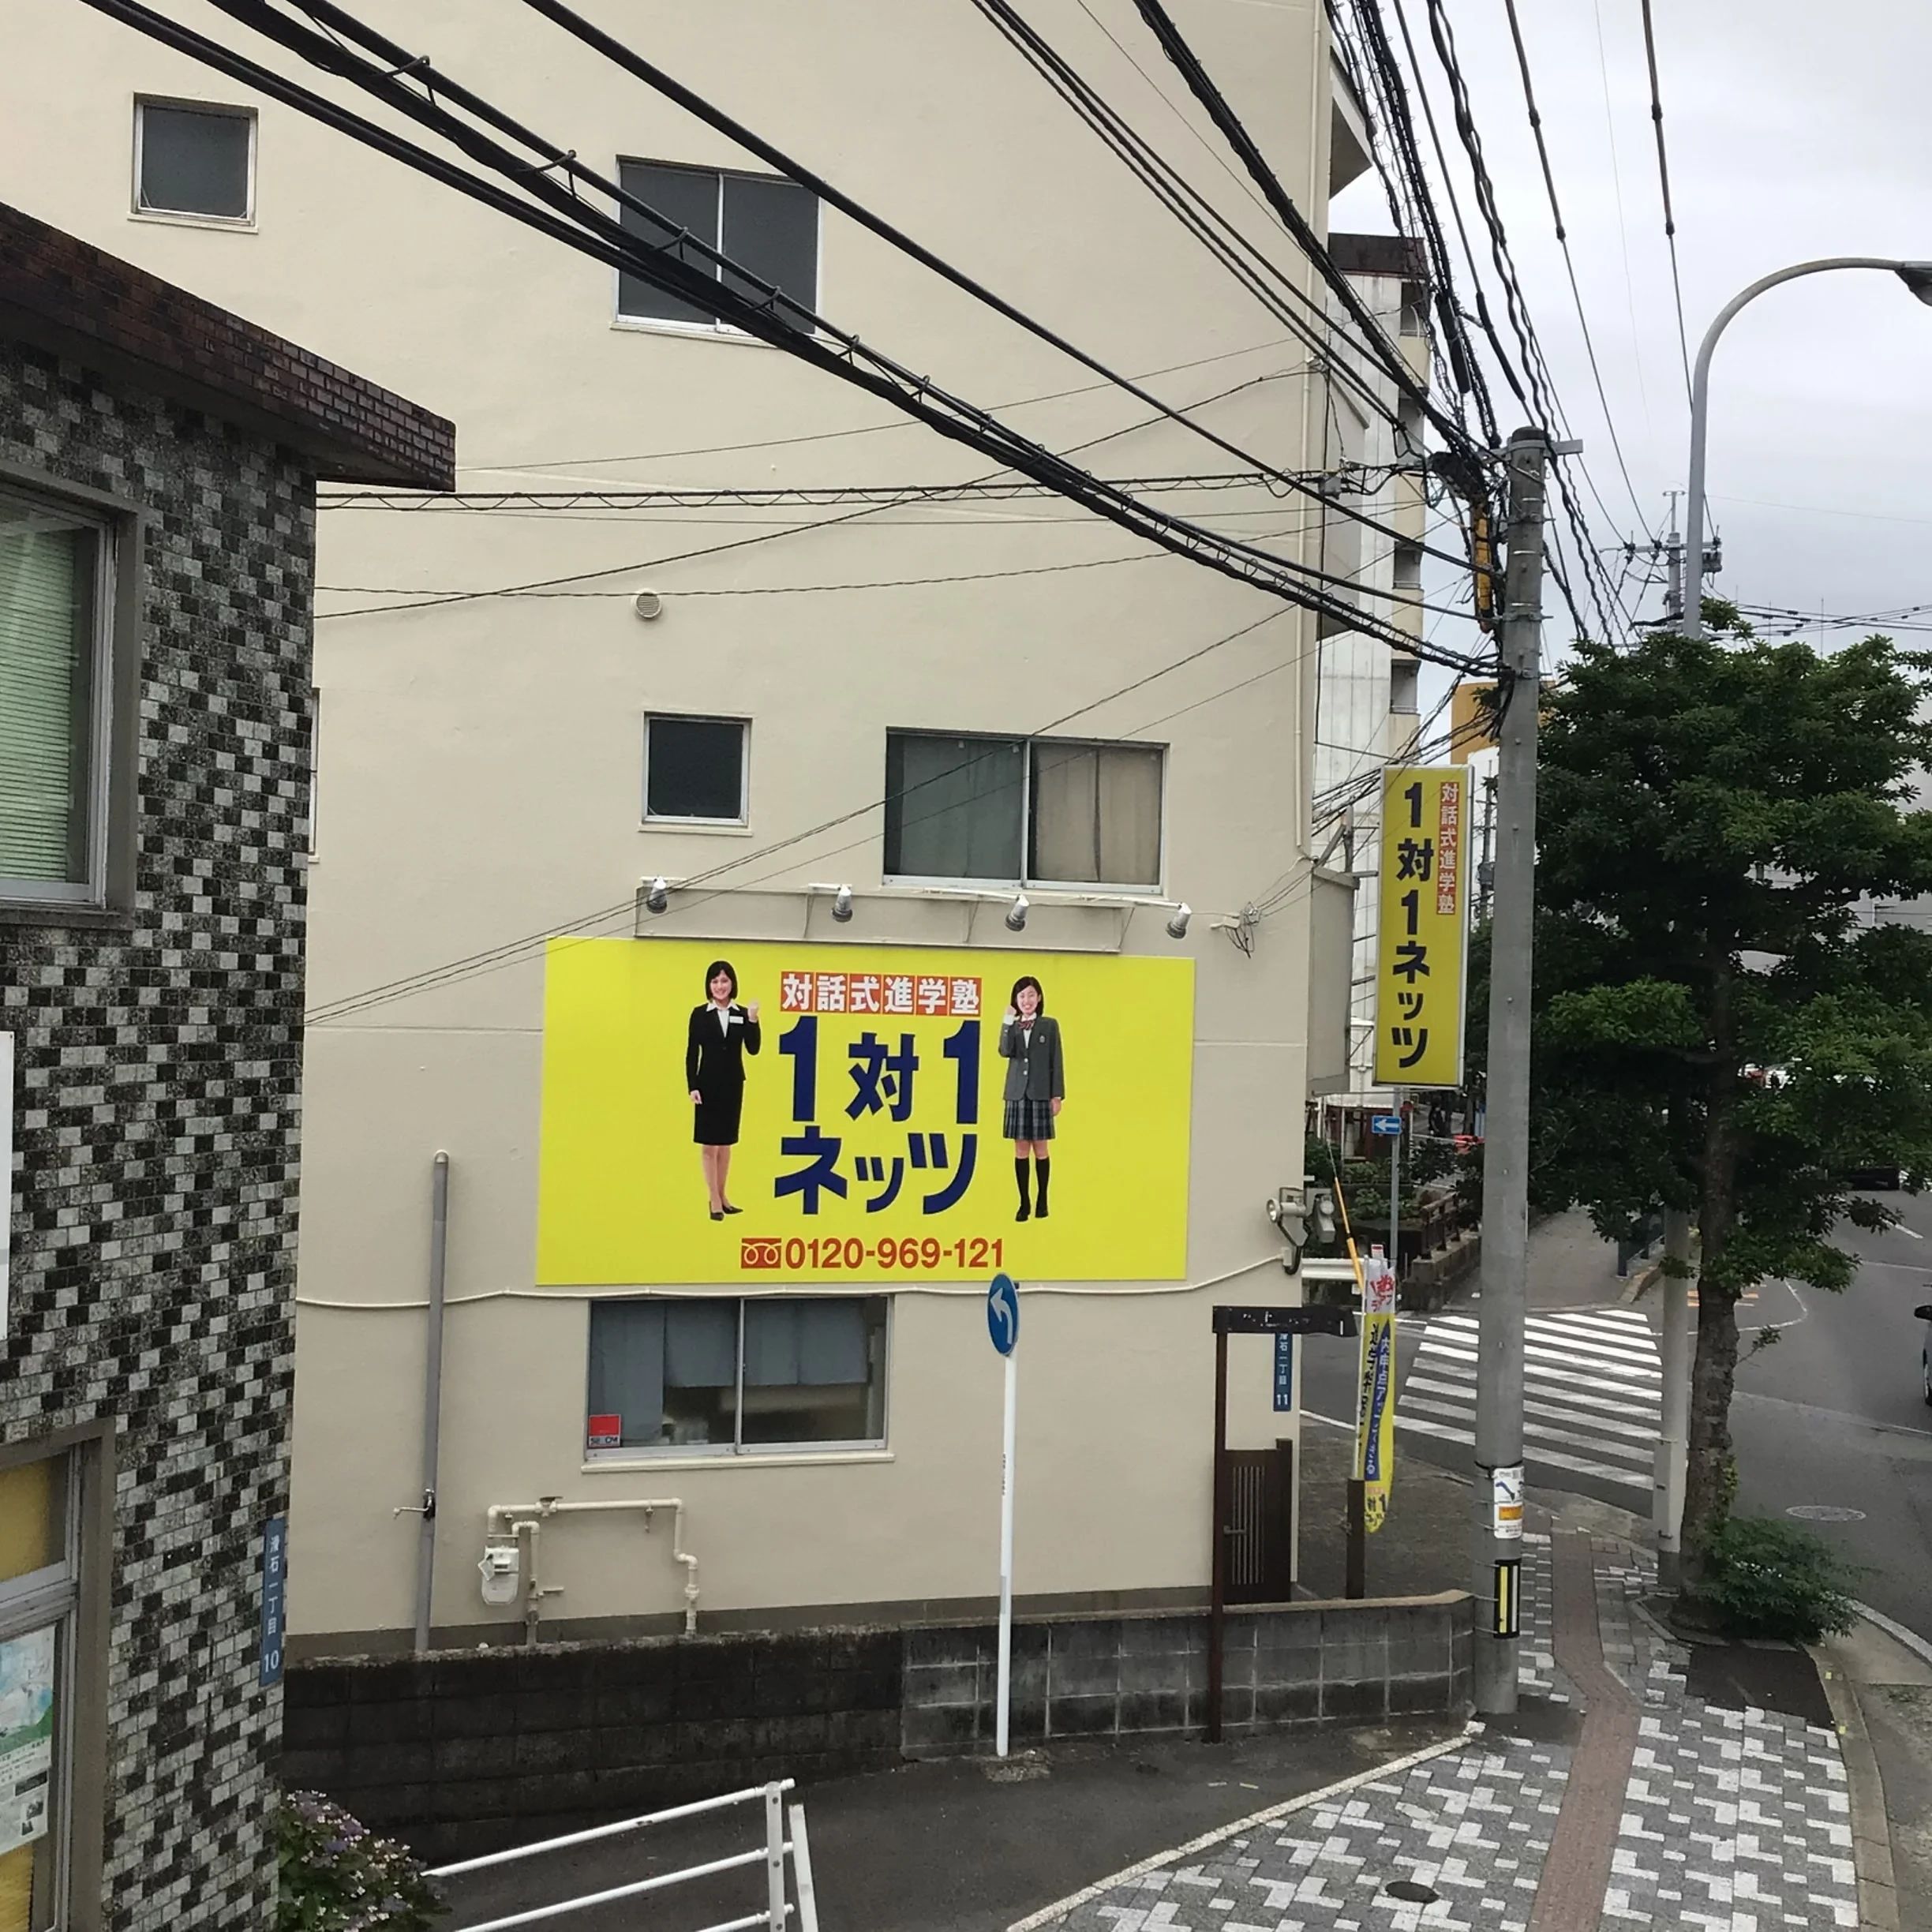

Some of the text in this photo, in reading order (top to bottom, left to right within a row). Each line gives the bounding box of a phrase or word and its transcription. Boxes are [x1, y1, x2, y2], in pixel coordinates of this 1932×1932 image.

[1438, 782, 1458, 913] 対話式進学塾
[1392, 781, 1434, 1069] 1対1ネッツ
[781, 972, 979, 1015] 対話式進学塾
[778, 1015, 981, 1125] 1対1
[774, 1125, 977, 1215] ネッツ
[784, 1237, 1002, 1269] 0120-969-121
[1276, 1393, 1288, 1406] 11
[264, 1649, 279, 1673] 10
